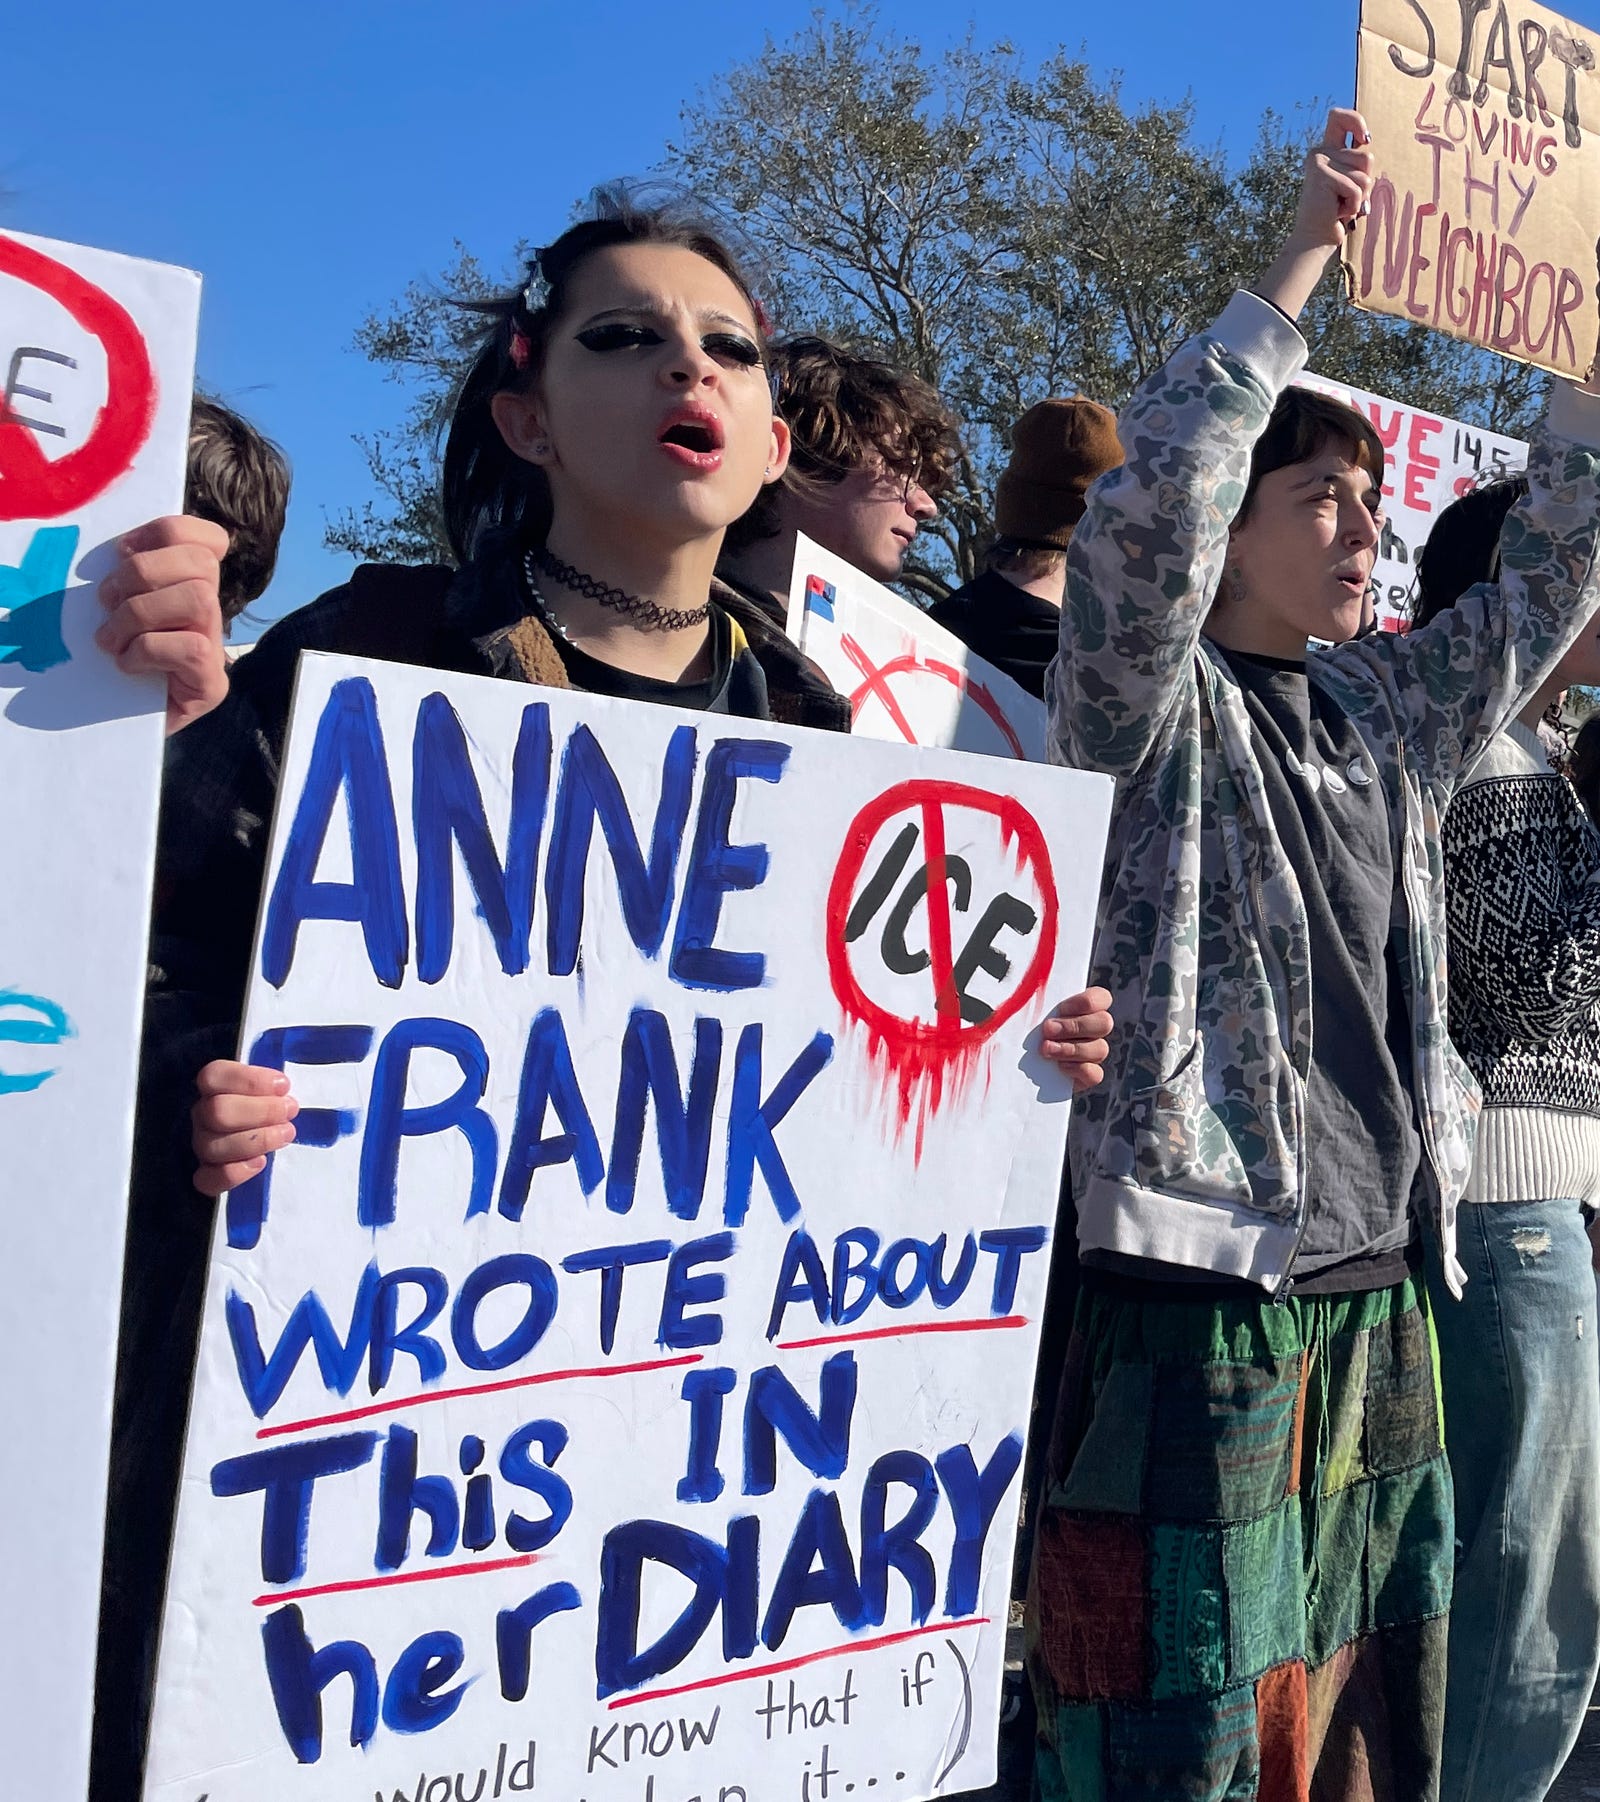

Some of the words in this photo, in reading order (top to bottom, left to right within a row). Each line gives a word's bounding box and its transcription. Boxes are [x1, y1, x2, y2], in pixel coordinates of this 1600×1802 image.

[1388, 0, 1597, 148] START
[1415, 82, 1558, 176] LOVING
[1361, 172, 1585, 366] NEIGHBOR
[1415, 133, 1538, 238] THY
[262, 675, 793, 991] ANNE
[843, 823, 1038, 1023] ICE
[226, 1004, 835, 1250] FRANK
[226, 1231, 740, 1419] WROTE
[768, 1223, 1051, 1341] ABOUT
[211, 1419, 574, 1584] This
[675, 1350, 857, 1504] IN
[262, 1580, 583, 1764] her
[596, 1427, 1026, 1707] DIARY
[374, 1740, 536, 1802] would
[587, 1707, 721, 1774] know
[755, 1669, 859, 1740] that
[901, 1651, 936, 1708] if
